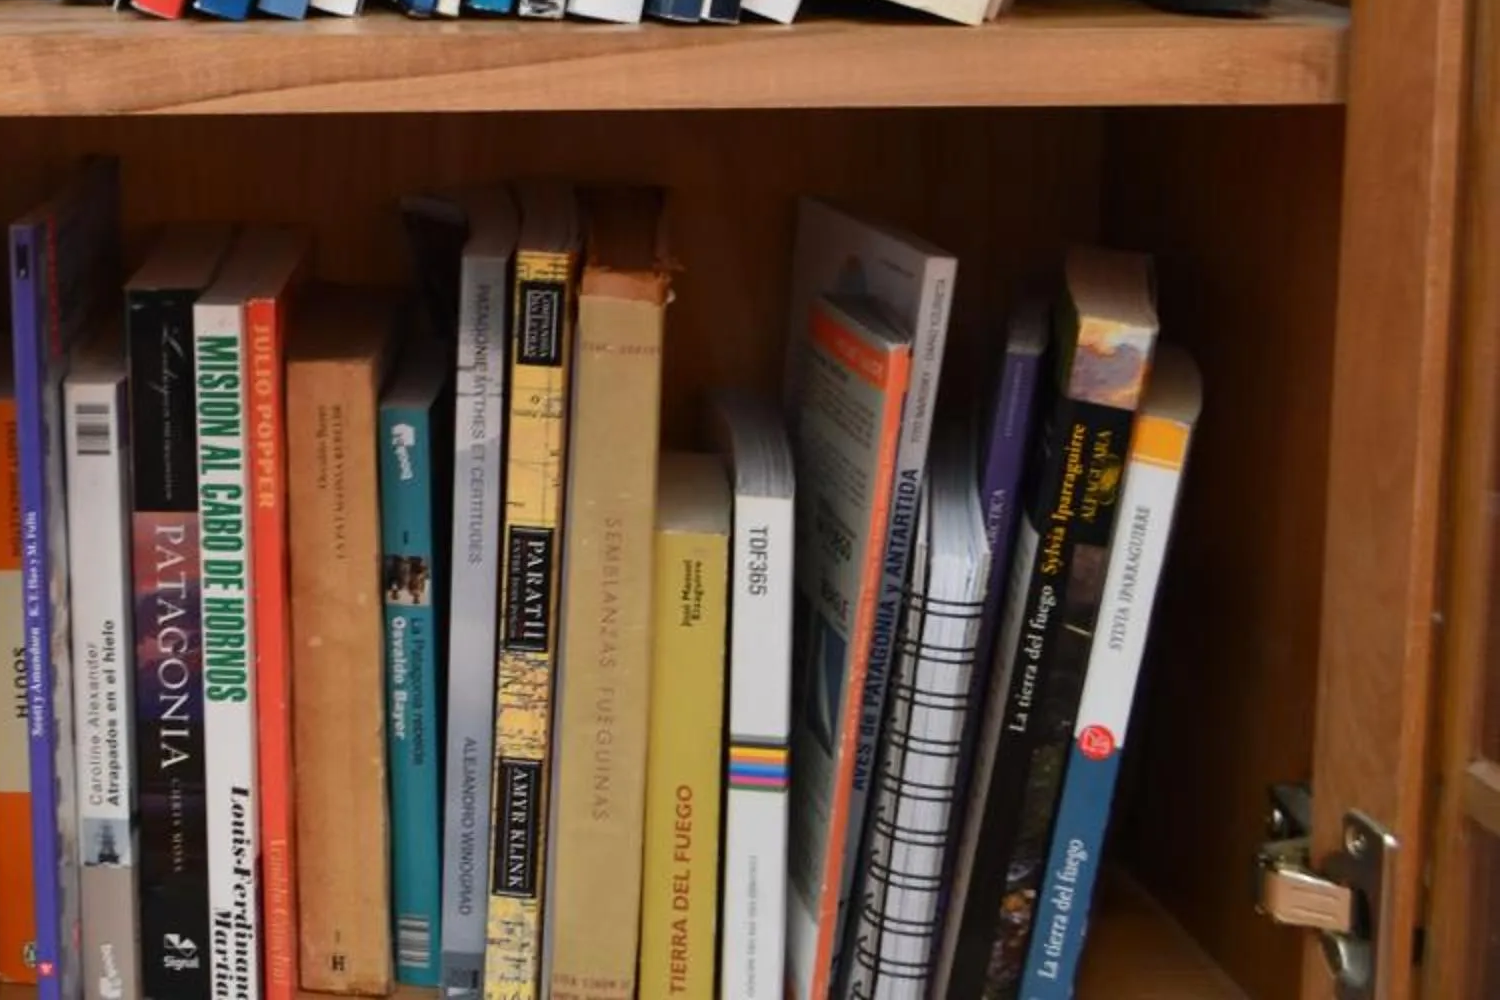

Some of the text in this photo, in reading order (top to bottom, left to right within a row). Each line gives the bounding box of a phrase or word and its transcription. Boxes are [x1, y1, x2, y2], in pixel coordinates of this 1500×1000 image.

[252, 324, 276, 508] JULIO POPPER
[194, 334, 247, 705] MISION AL CABO DE HORNOS
[743, 524, 772, 597] TDF365
[1039, 422, 1092, 576] Sylvia Iparraguirre
[85, 643, 102, 805] Caroline Alexander
[101, 619, 121, 806] Atrapados en el hielo
[148, 523, 196, 769] PATAGONIA
[391, 616, 406, 739] Osvaldo Bayer
[591, 517, 621, 822] SEMBLANZAS FUEGUINAS
[1009, 583, 1060, 732] La tierra del fuego
[508, 768, 528, 888] AMYR KLINK
[668, 784, 695, 993] TIERRA DEL FUEGO
[1036, 836, 1090, 979] La tierra del fuego
